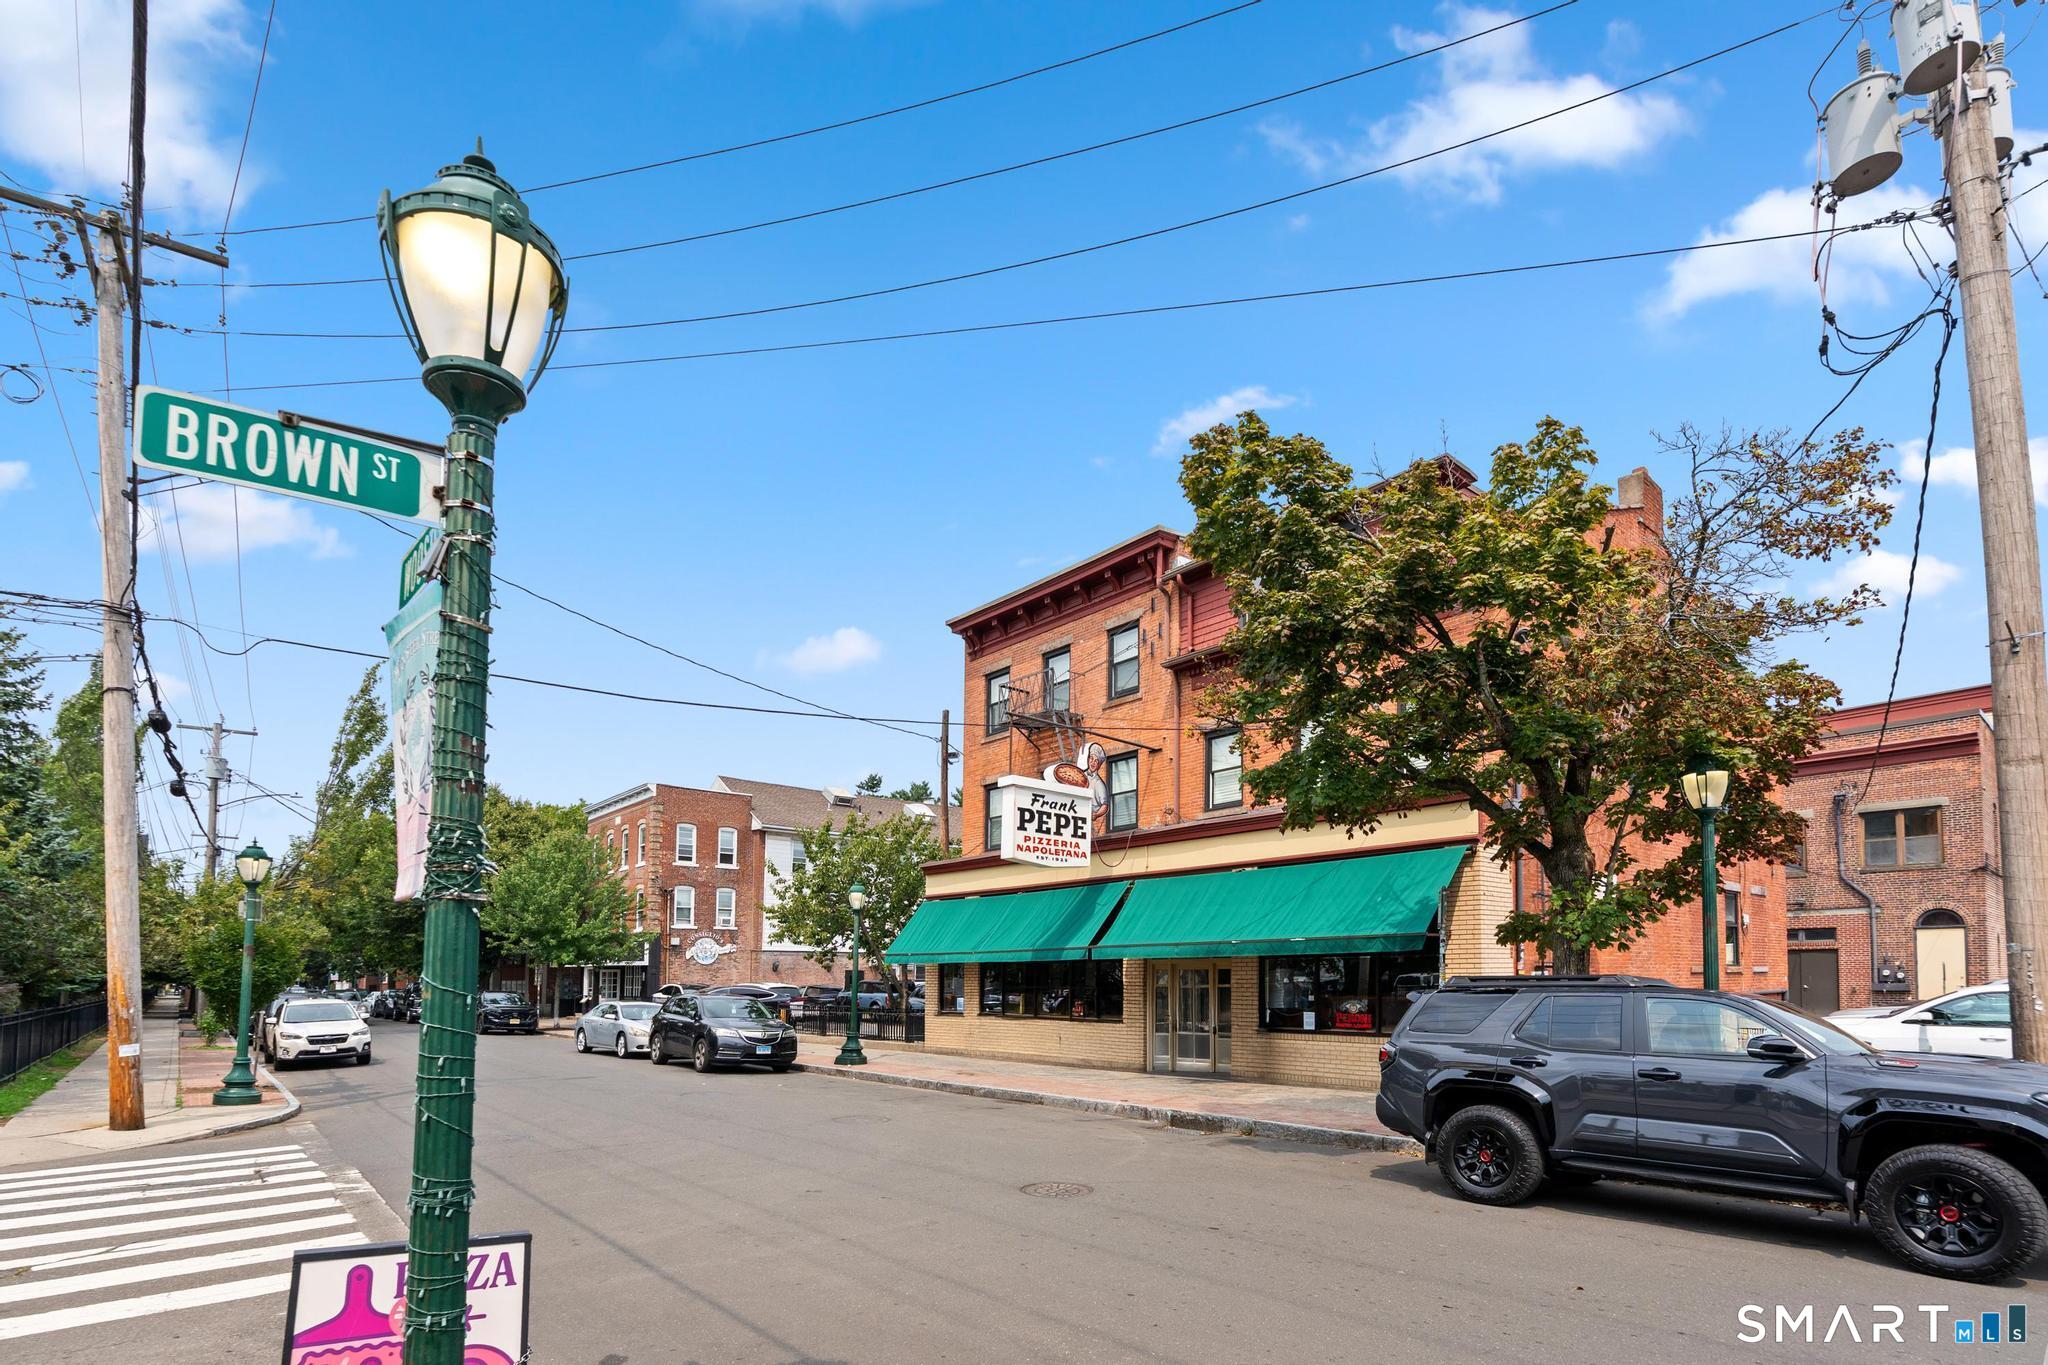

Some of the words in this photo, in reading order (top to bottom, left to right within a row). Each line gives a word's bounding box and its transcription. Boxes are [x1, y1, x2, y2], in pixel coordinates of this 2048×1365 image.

[165, 404, 360, 497] BROWN
[371, 453, 401, 482] ST
[1030, 793, 1078, 814] Frank
[1017, 807, 1087, 839] PEPE
[1017, 844, 1087, 859] NAPOLETANA
[1024, 835, 1080, 849] PIZZERIA
